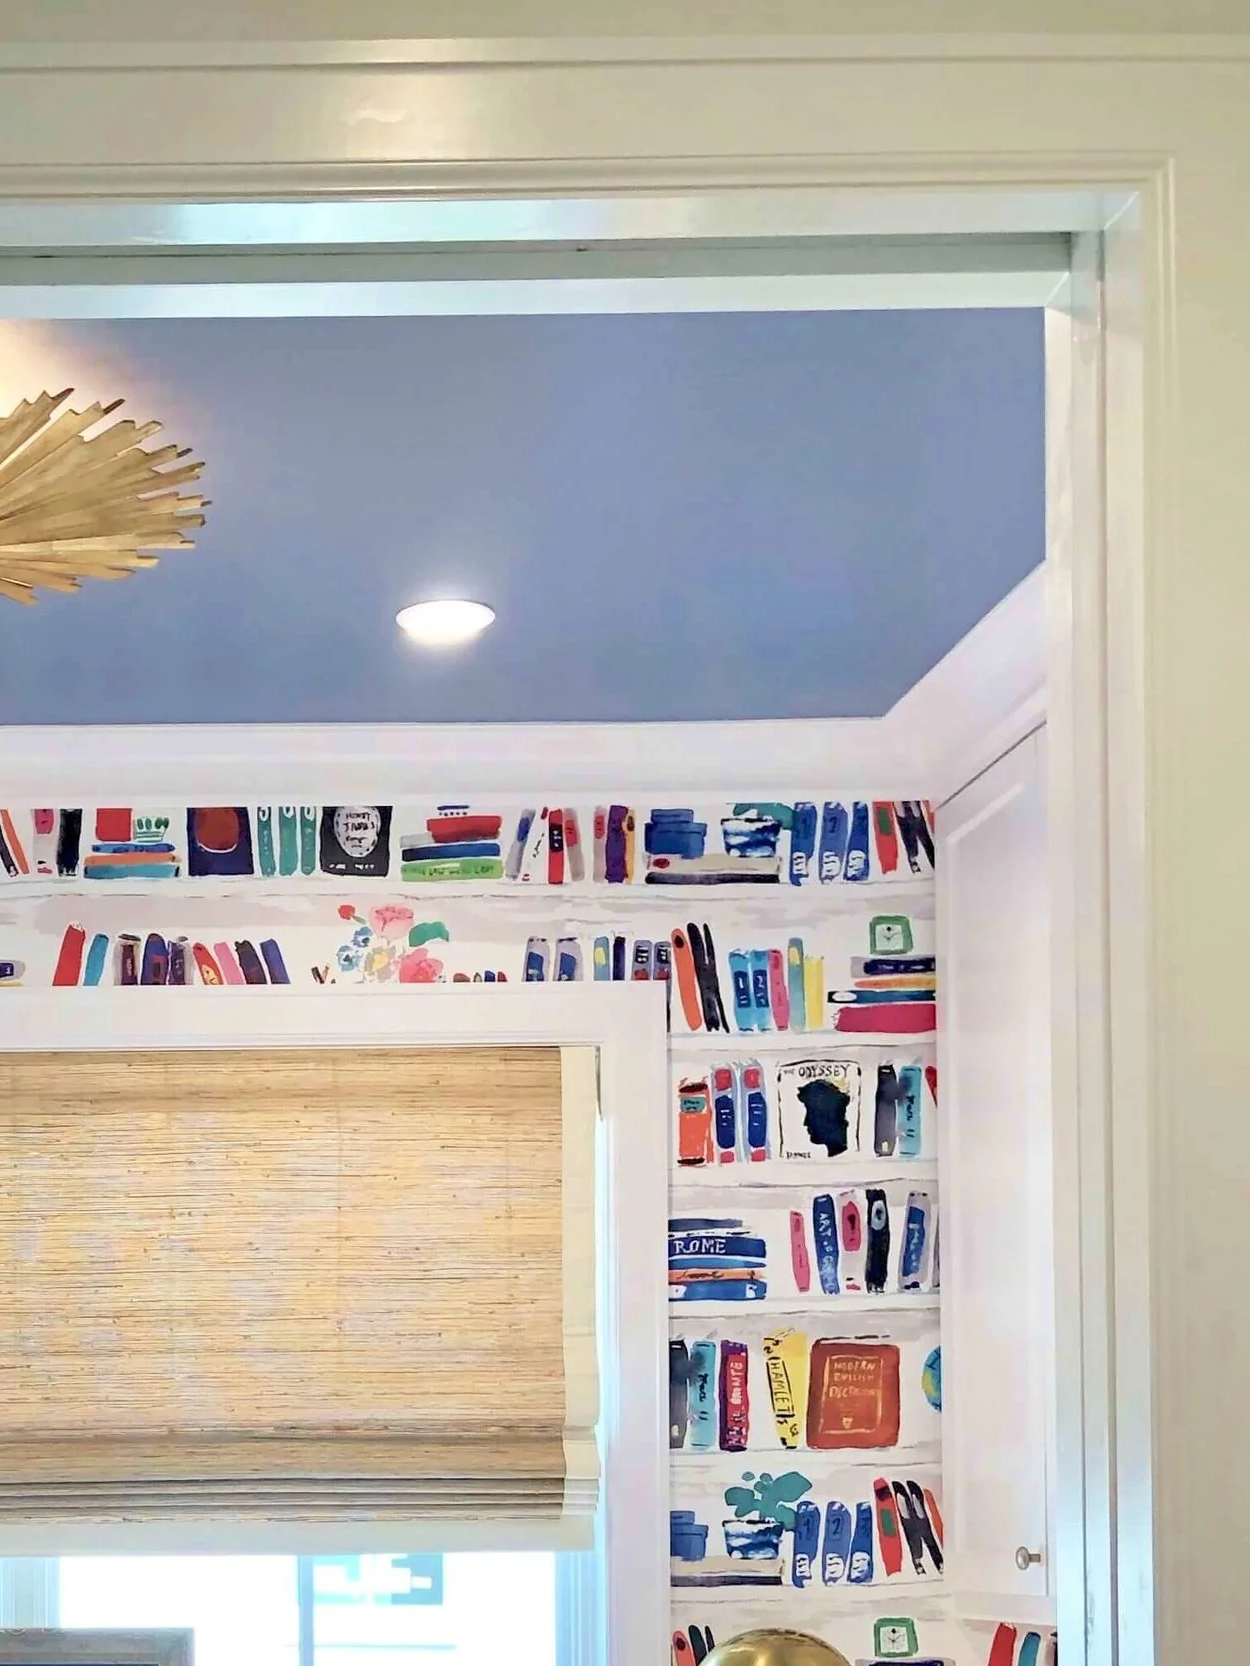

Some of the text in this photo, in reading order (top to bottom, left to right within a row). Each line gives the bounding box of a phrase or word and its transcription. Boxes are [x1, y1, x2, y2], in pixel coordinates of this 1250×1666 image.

[798, 1064, 851, 1078] ODYSSEY
[819, 1213, 832, 1237] ART
[673, 1238, 727, 1254] ROME
[770, 1362, 793, 1413] HAMLET
